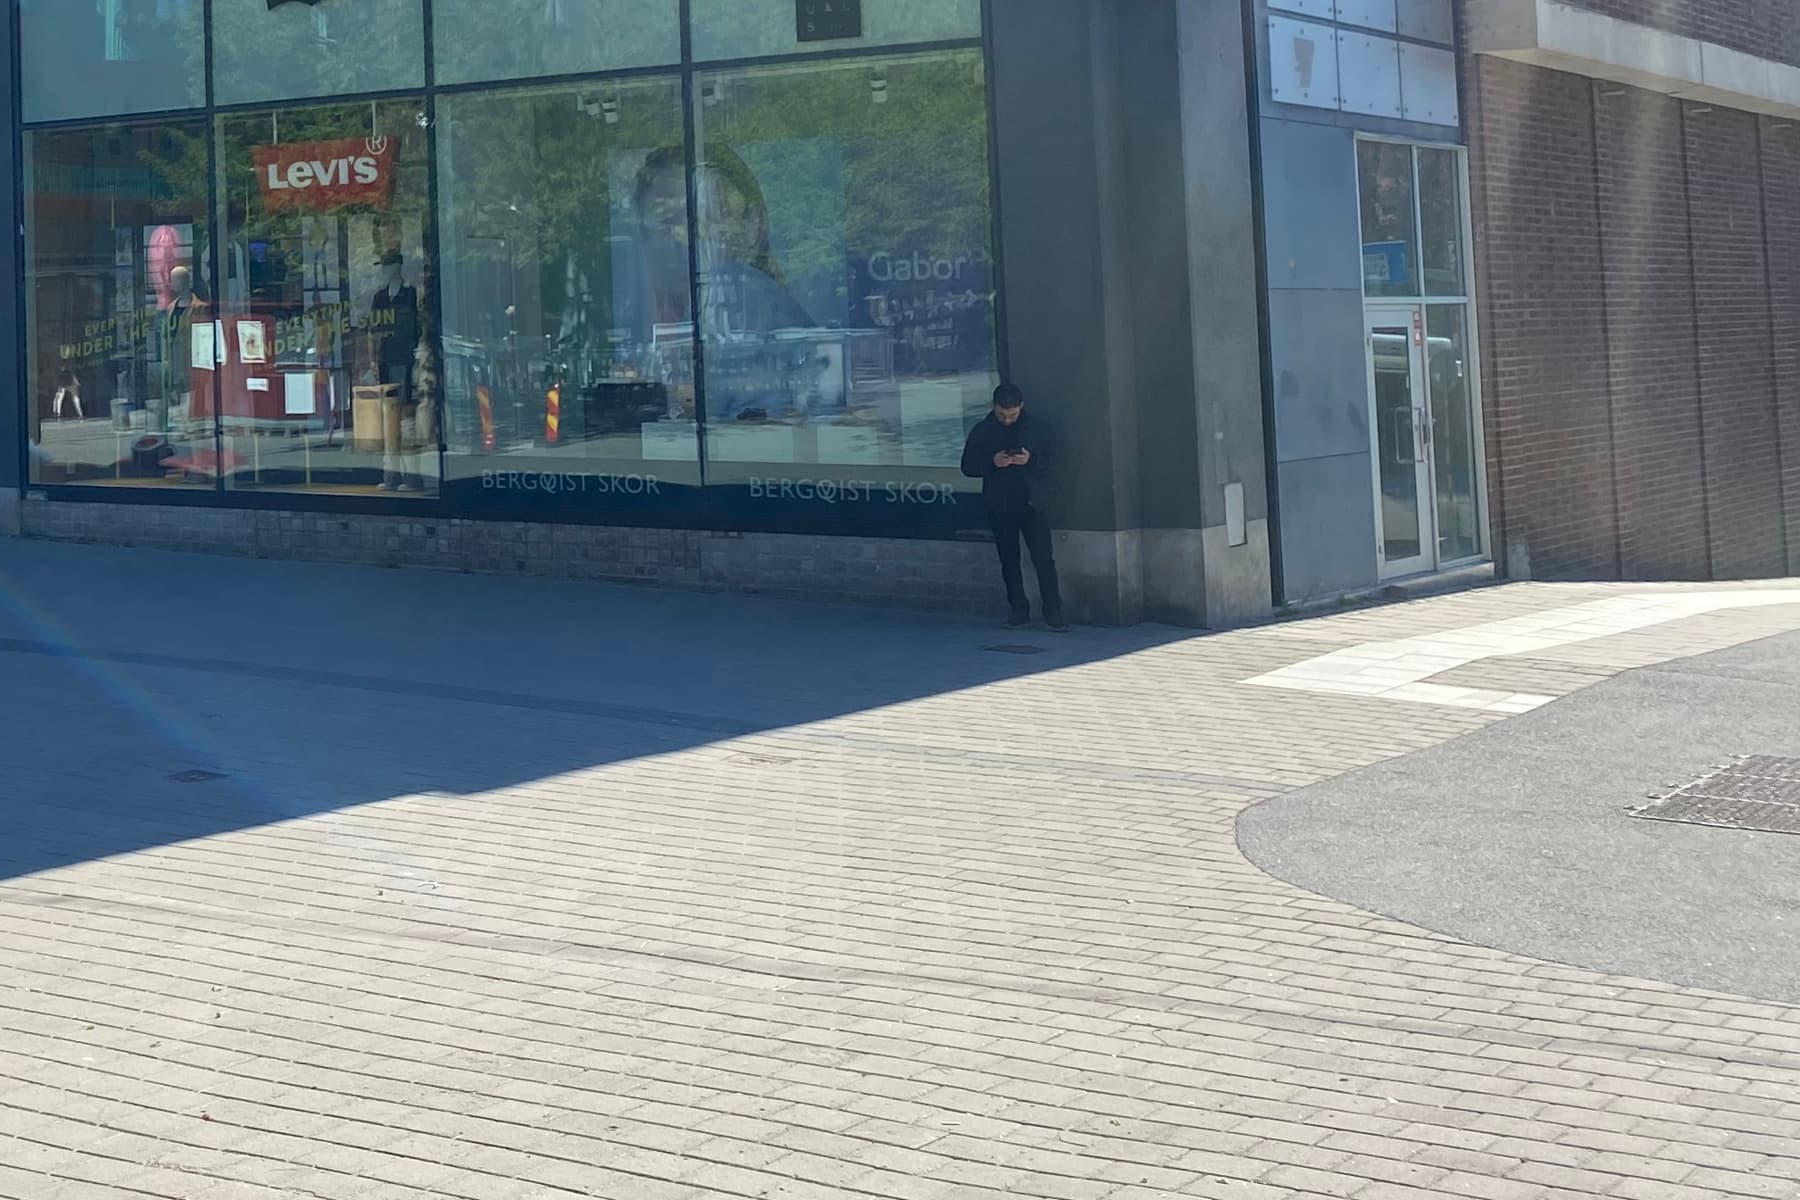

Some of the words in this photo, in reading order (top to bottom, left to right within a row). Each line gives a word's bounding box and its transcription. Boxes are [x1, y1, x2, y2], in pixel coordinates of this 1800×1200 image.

[867, 250, 968, 282] Gabor
[358, 308, 397, 330] SUN
[59, 334, 114, 360] UNDER
[598, 473, 661, 495] SKOR
[885, 481, 957, 505] SKOR
